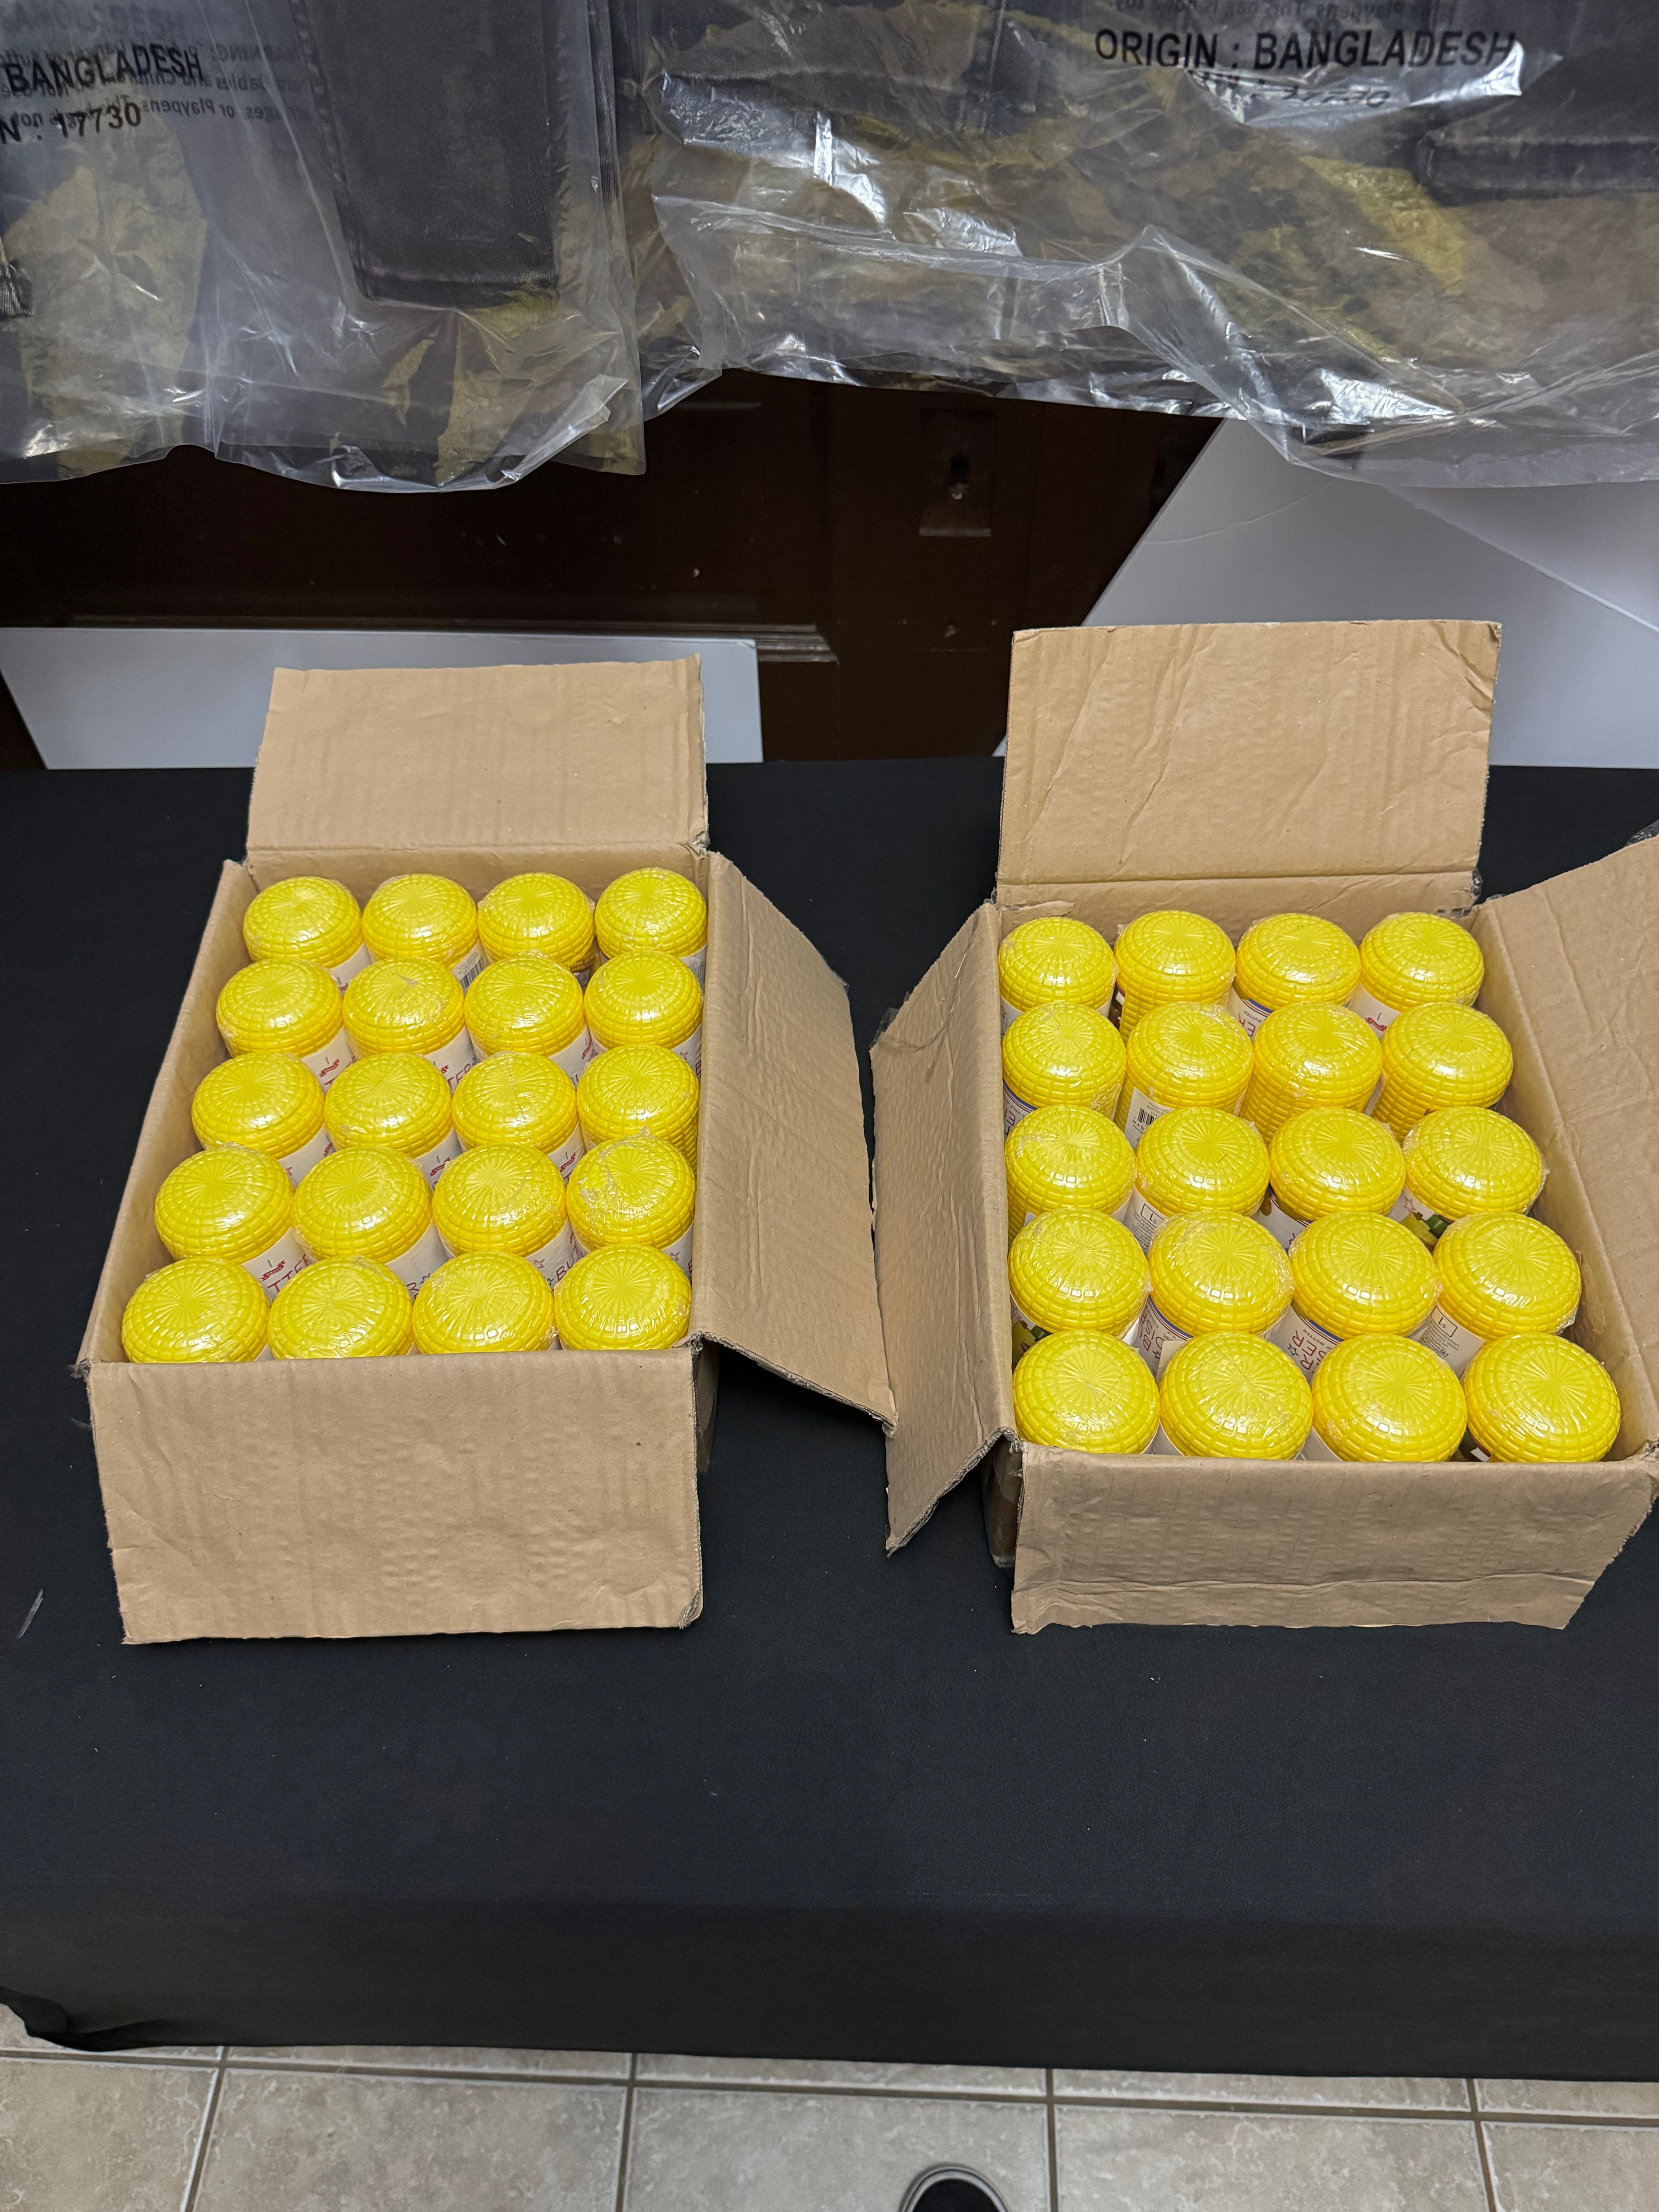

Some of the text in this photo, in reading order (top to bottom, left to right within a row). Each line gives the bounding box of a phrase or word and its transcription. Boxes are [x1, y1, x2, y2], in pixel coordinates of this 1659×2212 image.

[4, 43, 203, 92] BANGLADESH
[1095, 29, 1218, 68] ORIGIN
[1254, 29, 1516, 70] BANGLADESH
[57, 102, 142, 138] 17730
[1303, 1329, 1325, 1346] BUTTER
